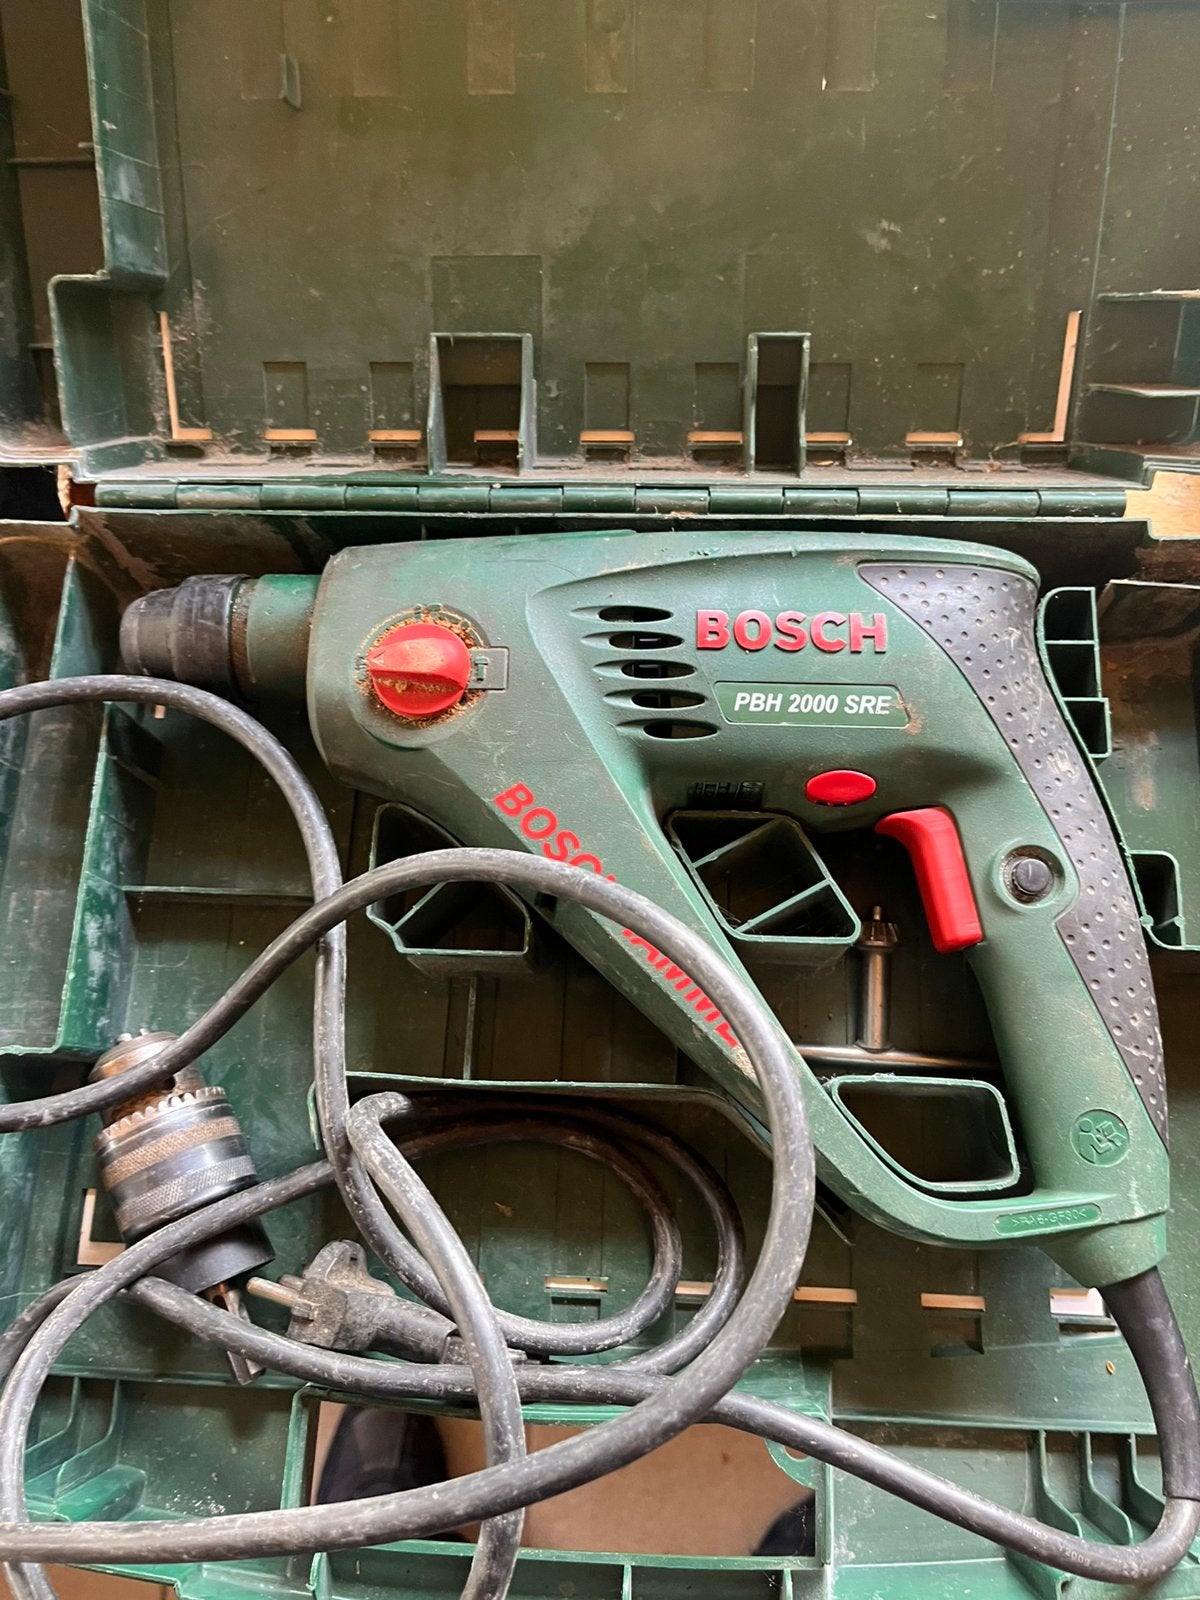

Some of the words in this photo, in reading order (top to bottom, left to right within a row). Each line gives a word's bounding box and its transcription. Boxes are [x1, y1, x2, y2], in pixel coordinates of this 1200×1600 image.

[696, 609, 888, 654] BOSCH
[733, 692, 783, 713] PBH
[788, 694, 839, 714] 2000
[844, 695, 893, 715] SRE
[493, 781, 617, 883] BOSC
